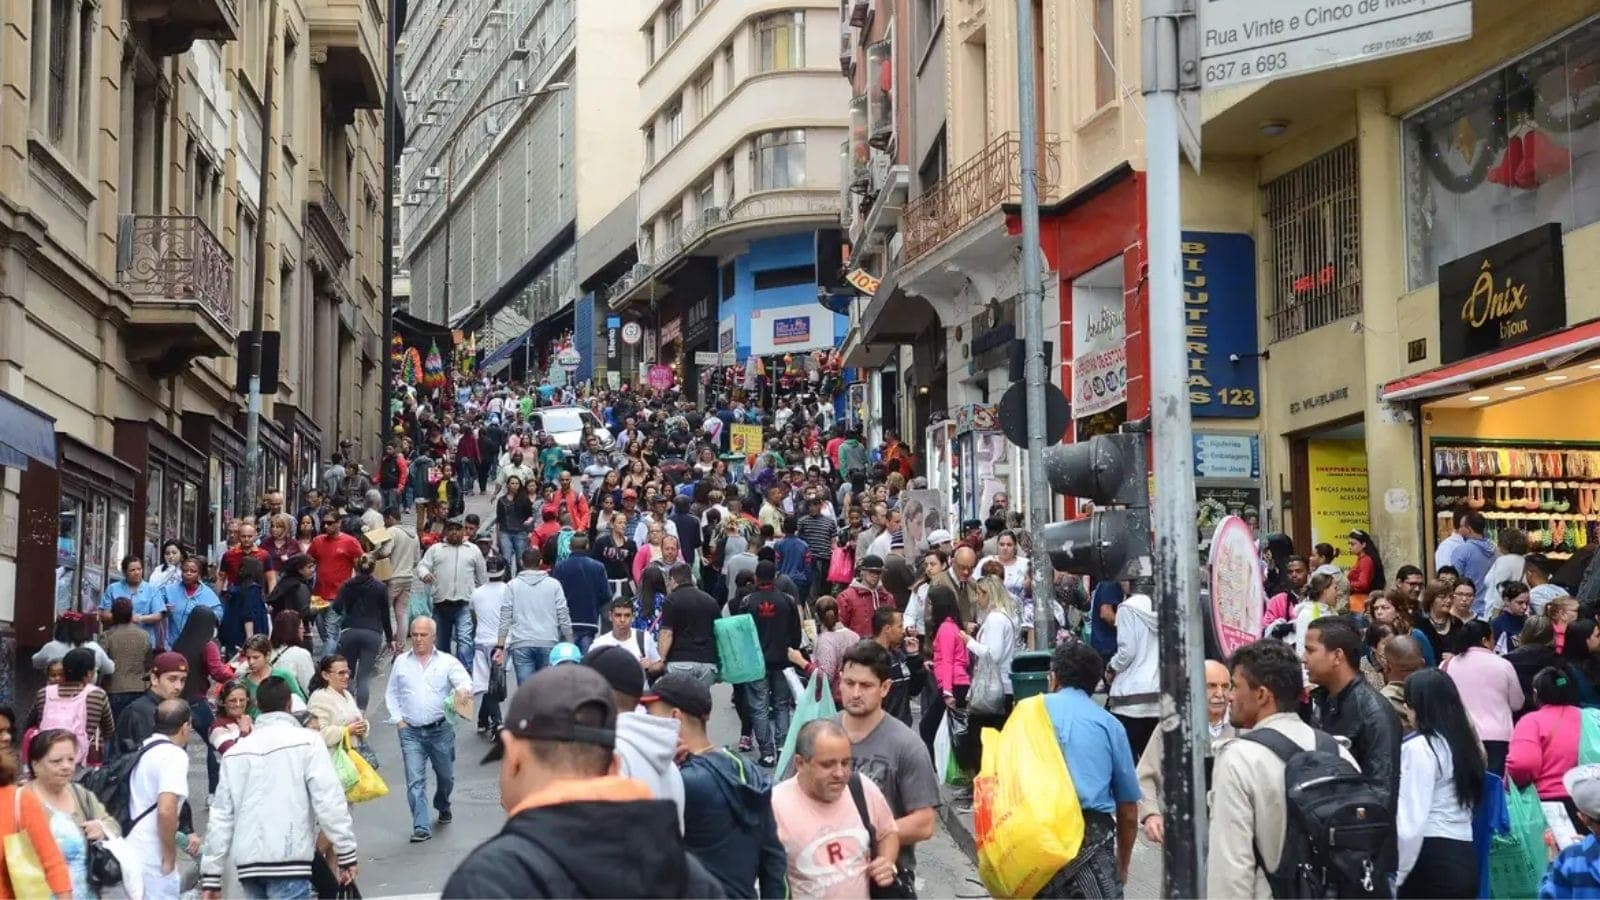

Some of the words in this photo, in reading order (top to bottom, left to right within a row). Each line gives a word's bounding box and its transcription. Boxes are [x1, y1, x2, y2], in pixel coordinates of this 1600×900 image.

[1205, 29, 1238, 48] Rua
[1242, 17, 1284, 40] Vinte
[1289, 18, 1300, 30] e
[1305, 5, 1353, 27] Cinco
[1358, 0, 1379, 14] de
[1362, 42, 1383, 54] CEP
[1206, 61, 1235, 83] 637
[1241, 63, 1251, 76] a
[1256, 52, 1288, 74] 693
[1461, 259, 1528, 328] Ônix
[1181, 241, 1212, 405] BIJUTERIAS
[1500, 318, 1529, 340] bijoux
[1217, 388, 1255, 406] 123
[826, 842, 844, 865] R
